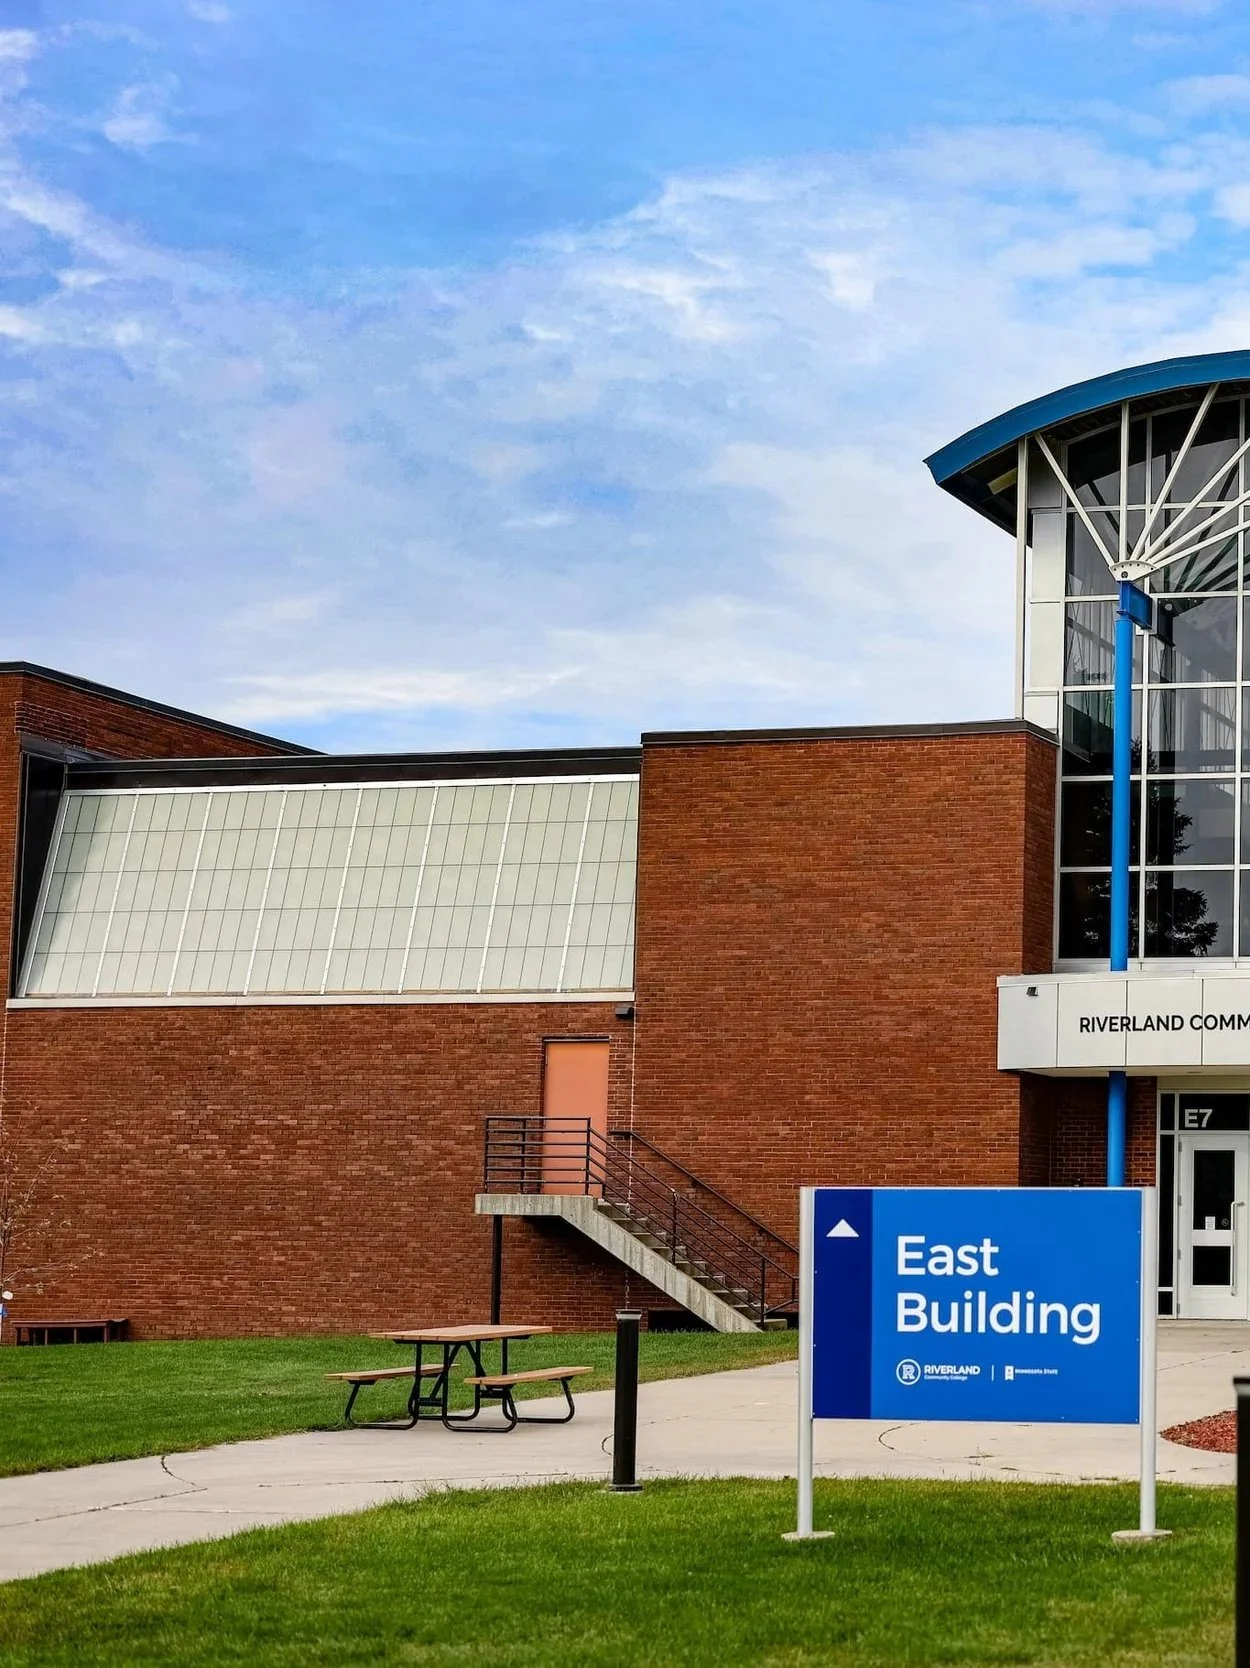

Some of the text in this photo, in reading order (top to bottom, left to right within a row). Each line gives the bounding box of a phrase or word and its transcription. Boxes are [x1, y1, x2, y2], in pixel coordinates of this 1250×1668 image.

[1079, 1015, 1184, 1033] RIVERLAND
[1184, 1108, 1213, 1128] E7
[897, 1235, 1000, 1276] East
[897, 1290, 1101, 1345] Building
[924, 1365, 980, 1375] RIVERLAND
